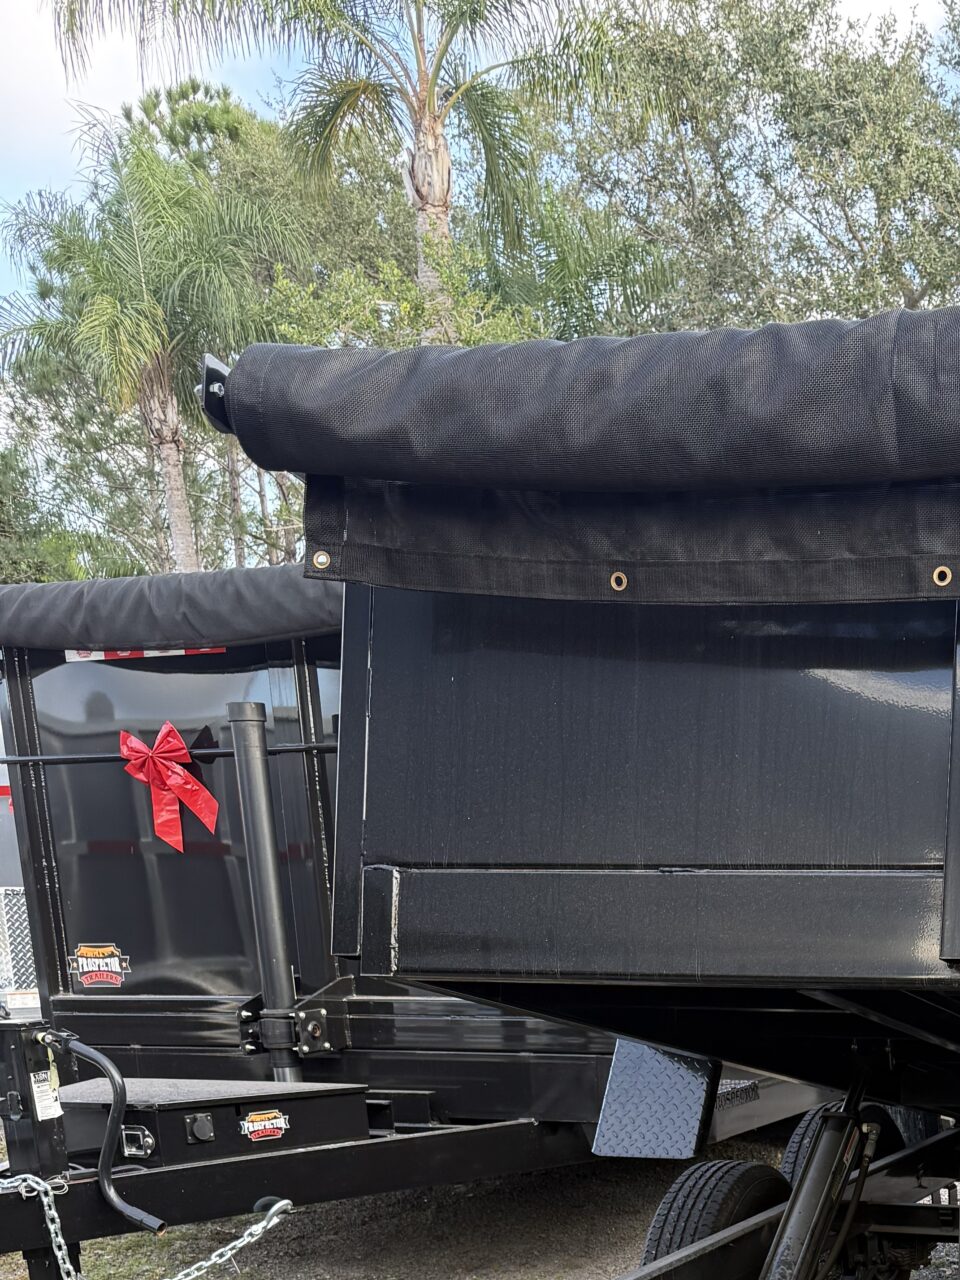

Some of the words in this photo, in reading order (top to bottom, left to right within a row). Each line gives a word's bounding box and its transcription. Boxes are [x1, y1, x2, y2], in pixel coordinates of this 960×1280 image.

[78, 957, 121, 972] PROSPECTOR
[84, 972, 119, 983] TRAILERS
[244, 1117, 286, 1134] PROSPECTOR
